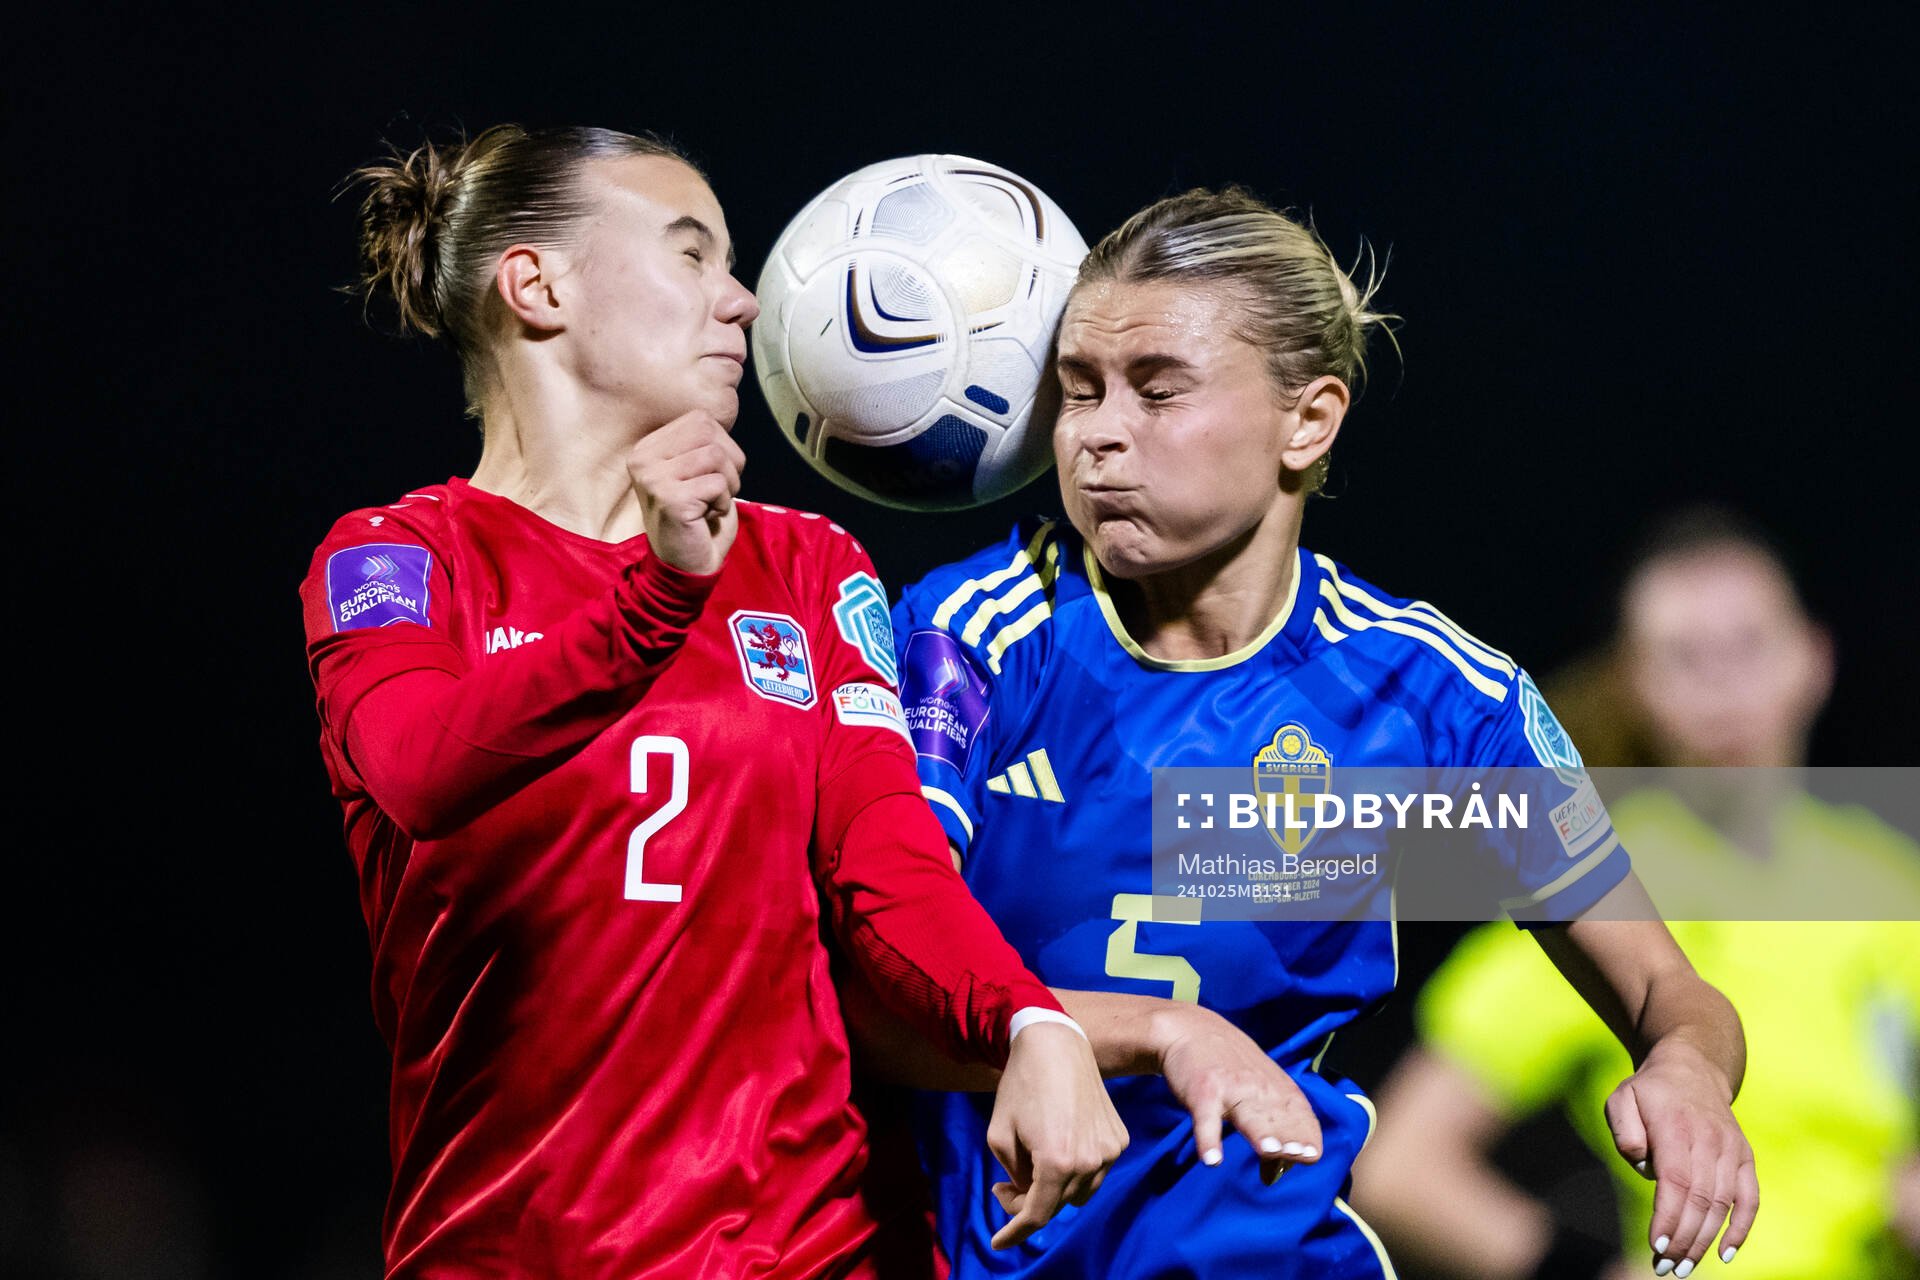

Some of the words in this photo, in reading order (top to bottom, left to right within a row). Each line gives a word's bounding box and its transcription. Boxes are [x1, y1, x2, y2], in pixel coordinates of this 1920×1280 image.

[340, 587, 416, 613] EUROPAN
[836, 685, 870, 695] UEFA
[904, 706, 968, 738] EUROPEAN
[907, 718, 966, 749] UALIFIERS
[1266, 763, 1318, 774] SVERIGE
[624, 735, 690, 903] 2
[1554, 801, 1578, 824] UEFA
[1303, 879, 1320, 890] 2024
[1105, 893, 1203, 1005] 5
